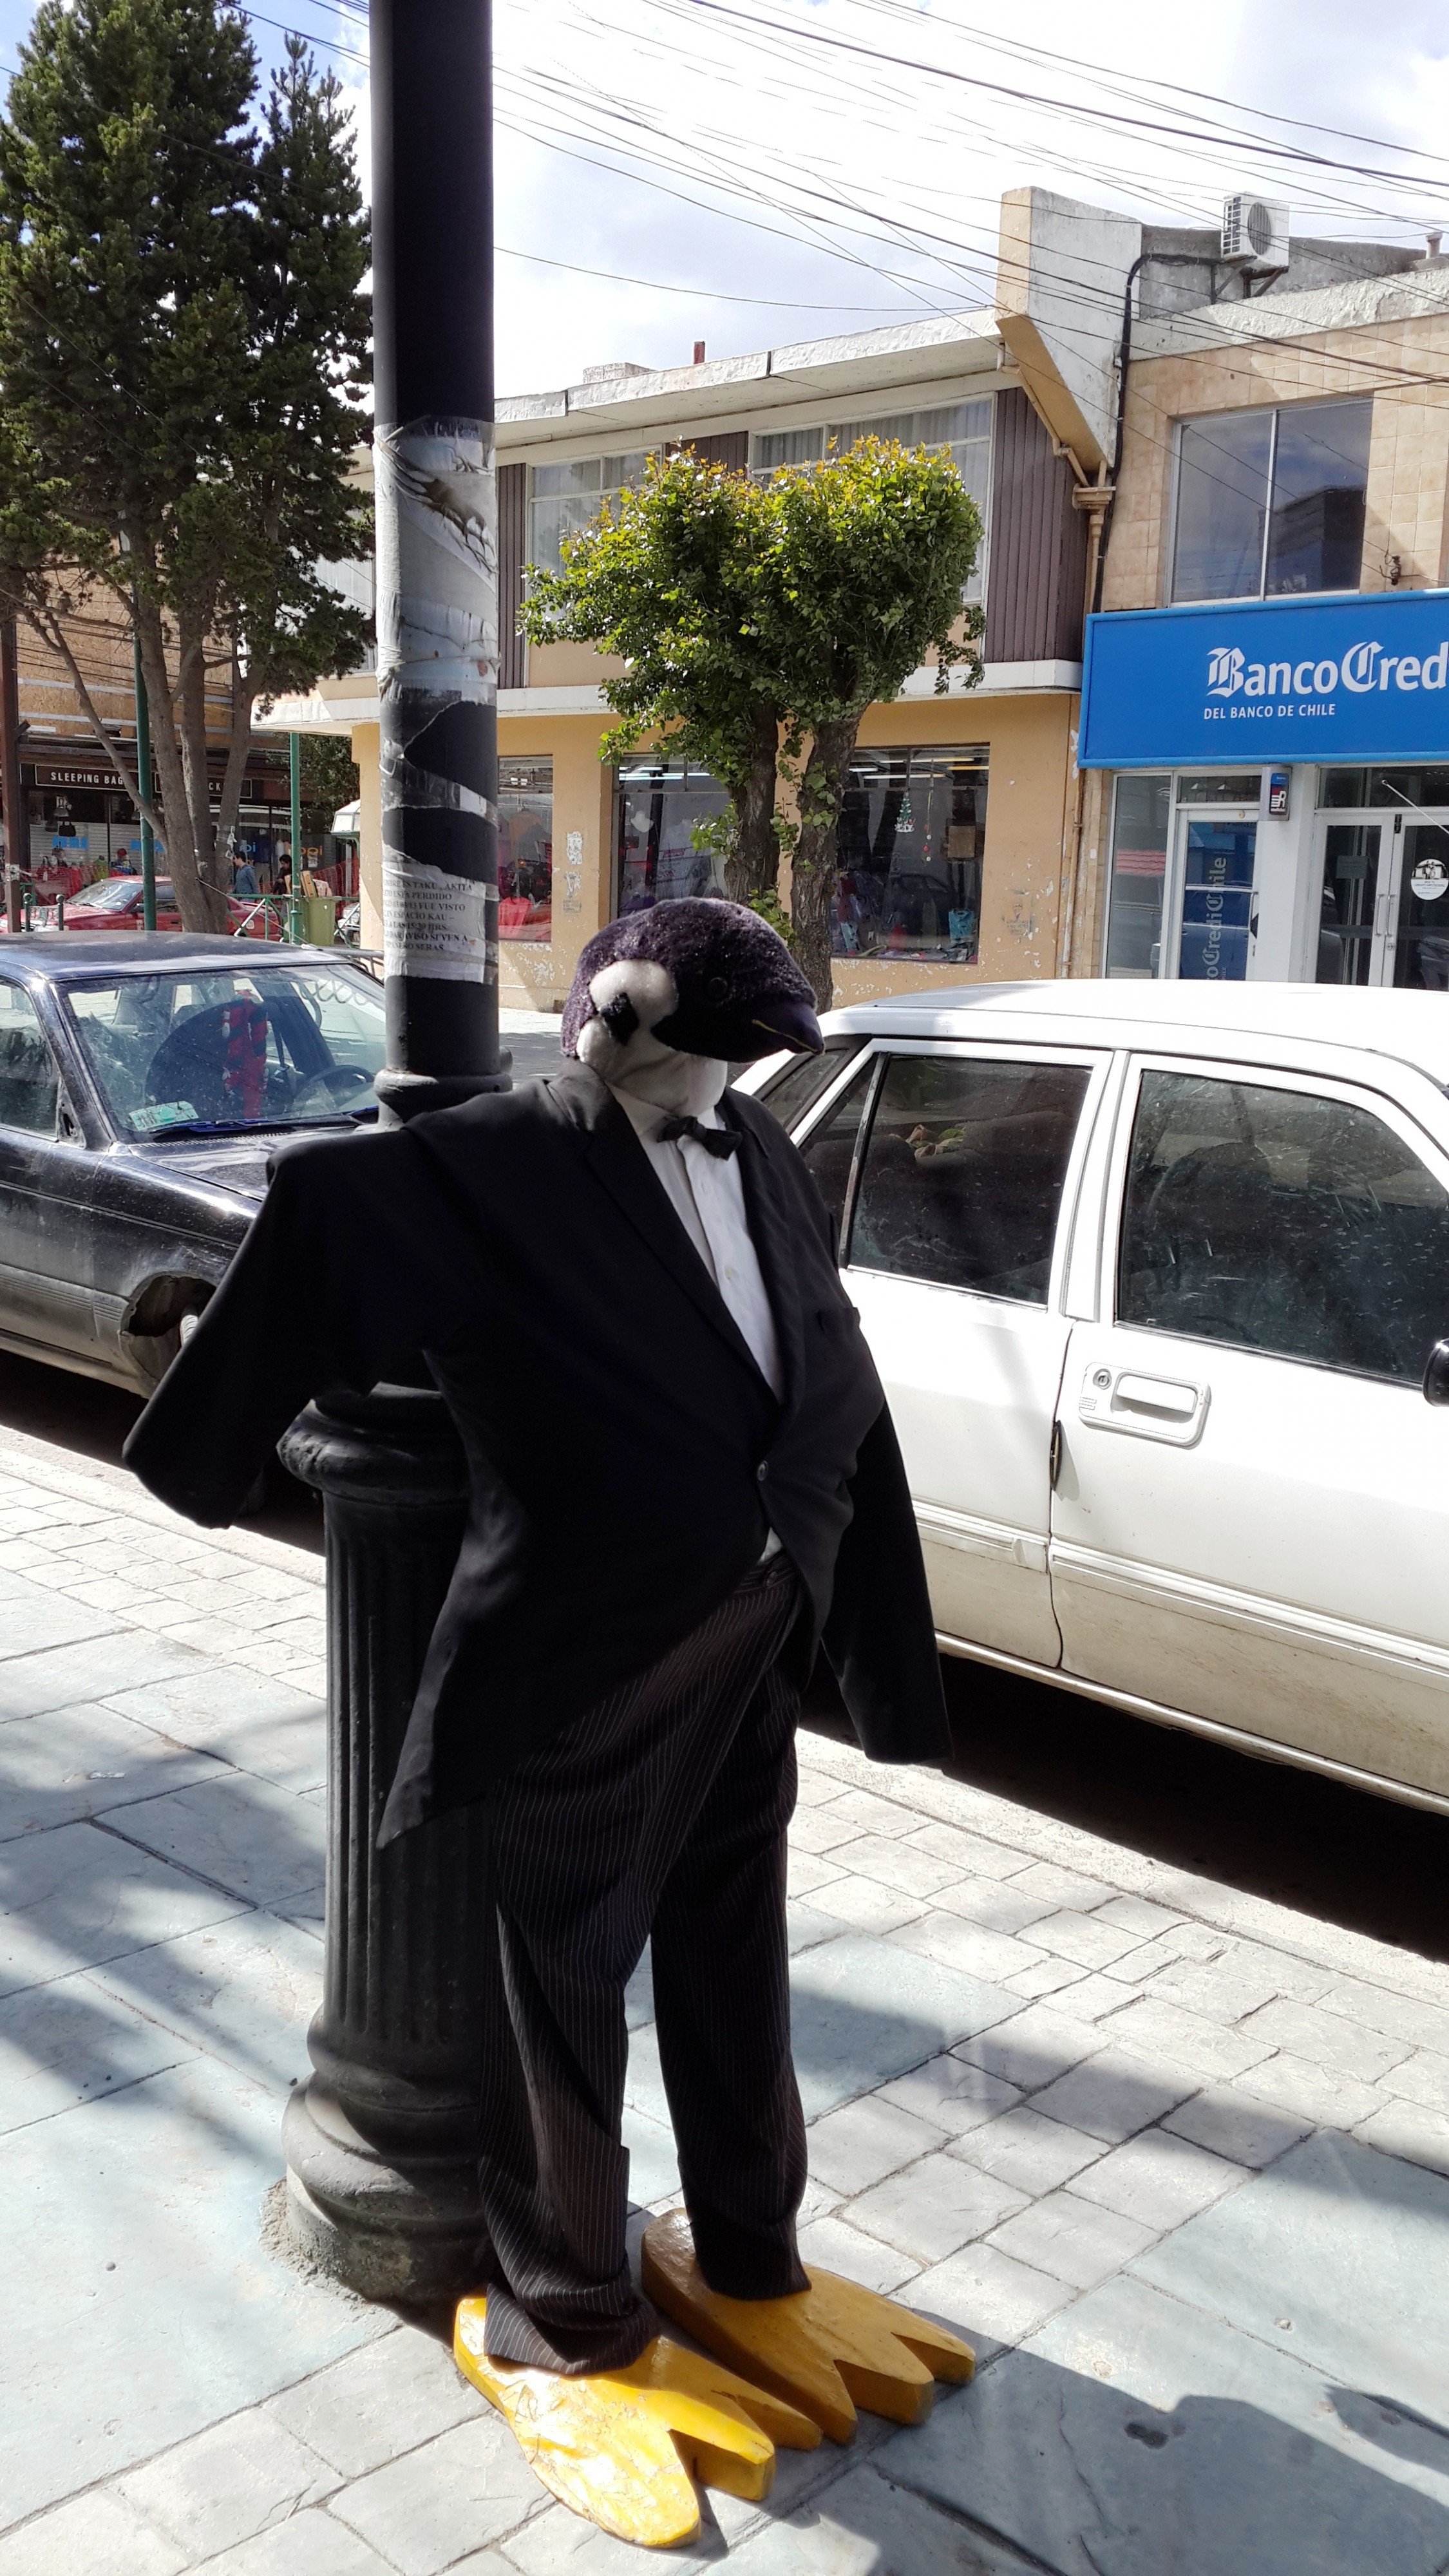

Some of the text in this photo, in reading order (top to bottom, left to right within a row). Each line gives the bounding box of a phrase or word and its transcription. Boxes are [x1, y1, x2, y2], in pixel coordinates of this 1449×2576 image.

[1204, 703, 1336, 719] DEL BANCO DE CHILE
[51, 772, 99, 784] SLEEPING
[1202, 857, 1227, 979] oCrediChile
[405, 933, 428, 941] AVISO
